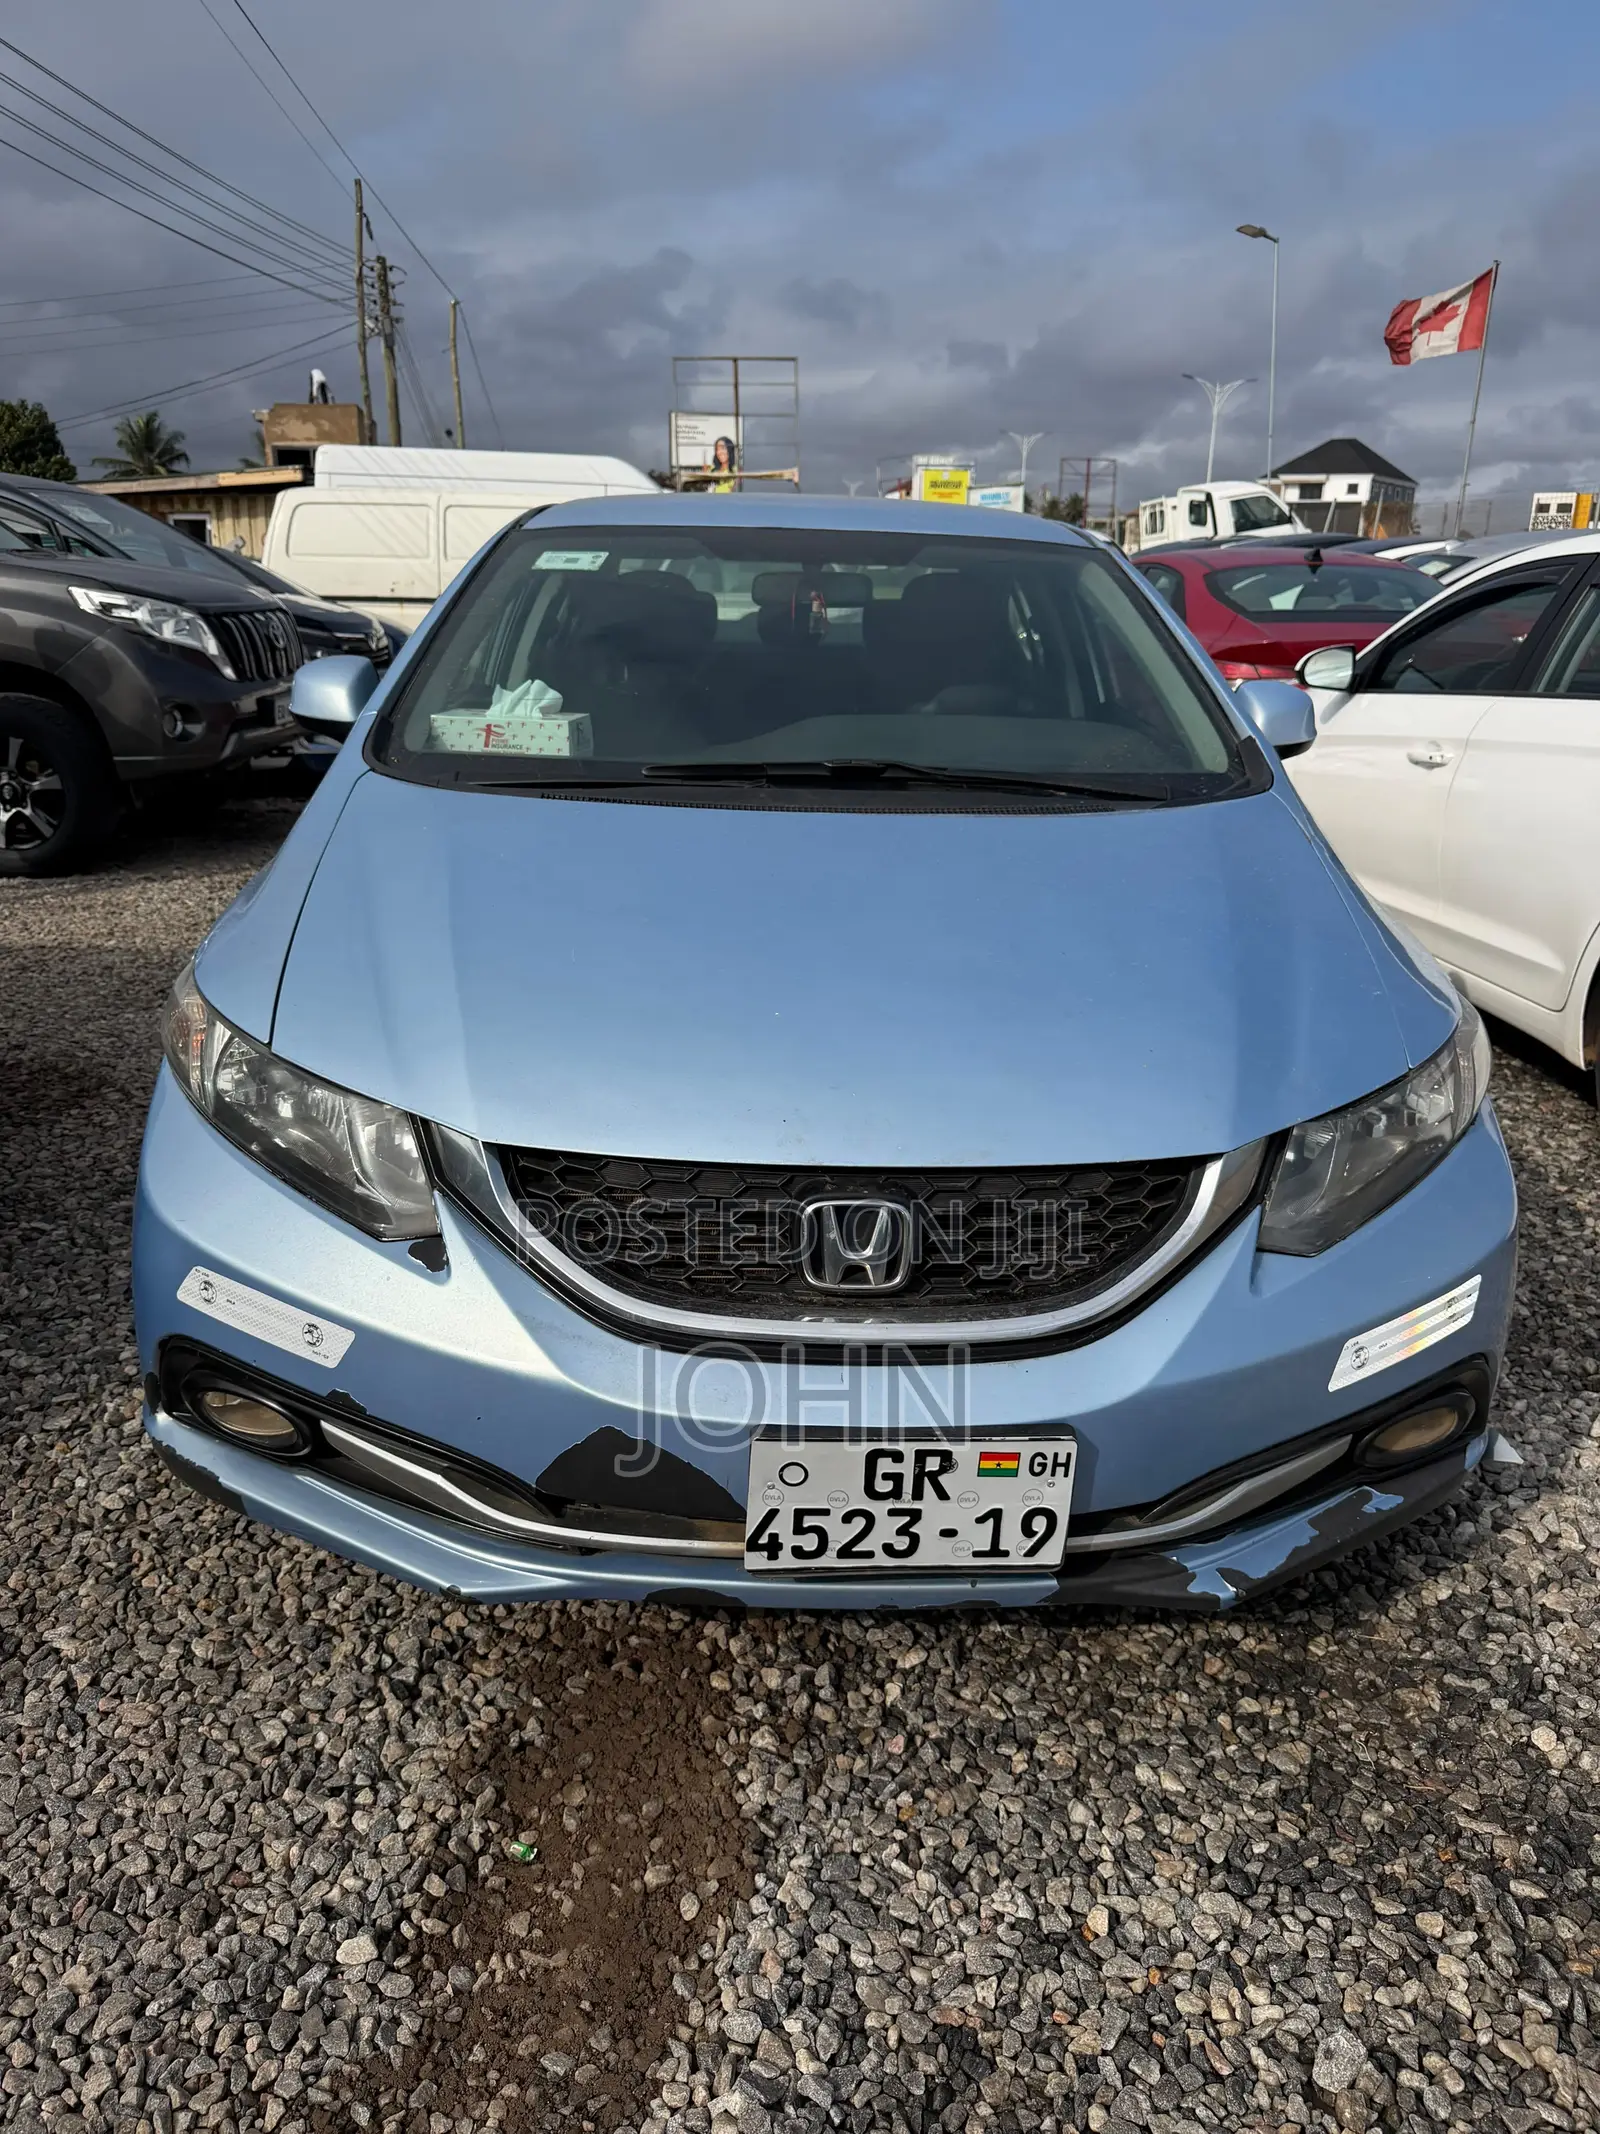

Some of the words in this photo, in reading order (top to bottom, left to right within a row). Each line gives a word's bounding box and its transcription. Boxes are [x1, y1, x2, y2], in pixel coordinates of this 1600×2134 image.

[1028, 1452, 1072, 1478] GH
[863, 1448, 953, 1501] GR
[764, 1494, 783, 1502] DVLA
[829, 1495, 847, 1503] DVLA
[959, 1496, 977, 1504] DVLA
[1024, 1494, 1042, 1502] DVLA
[746, 1507, 1058, 1560] 4523-19
